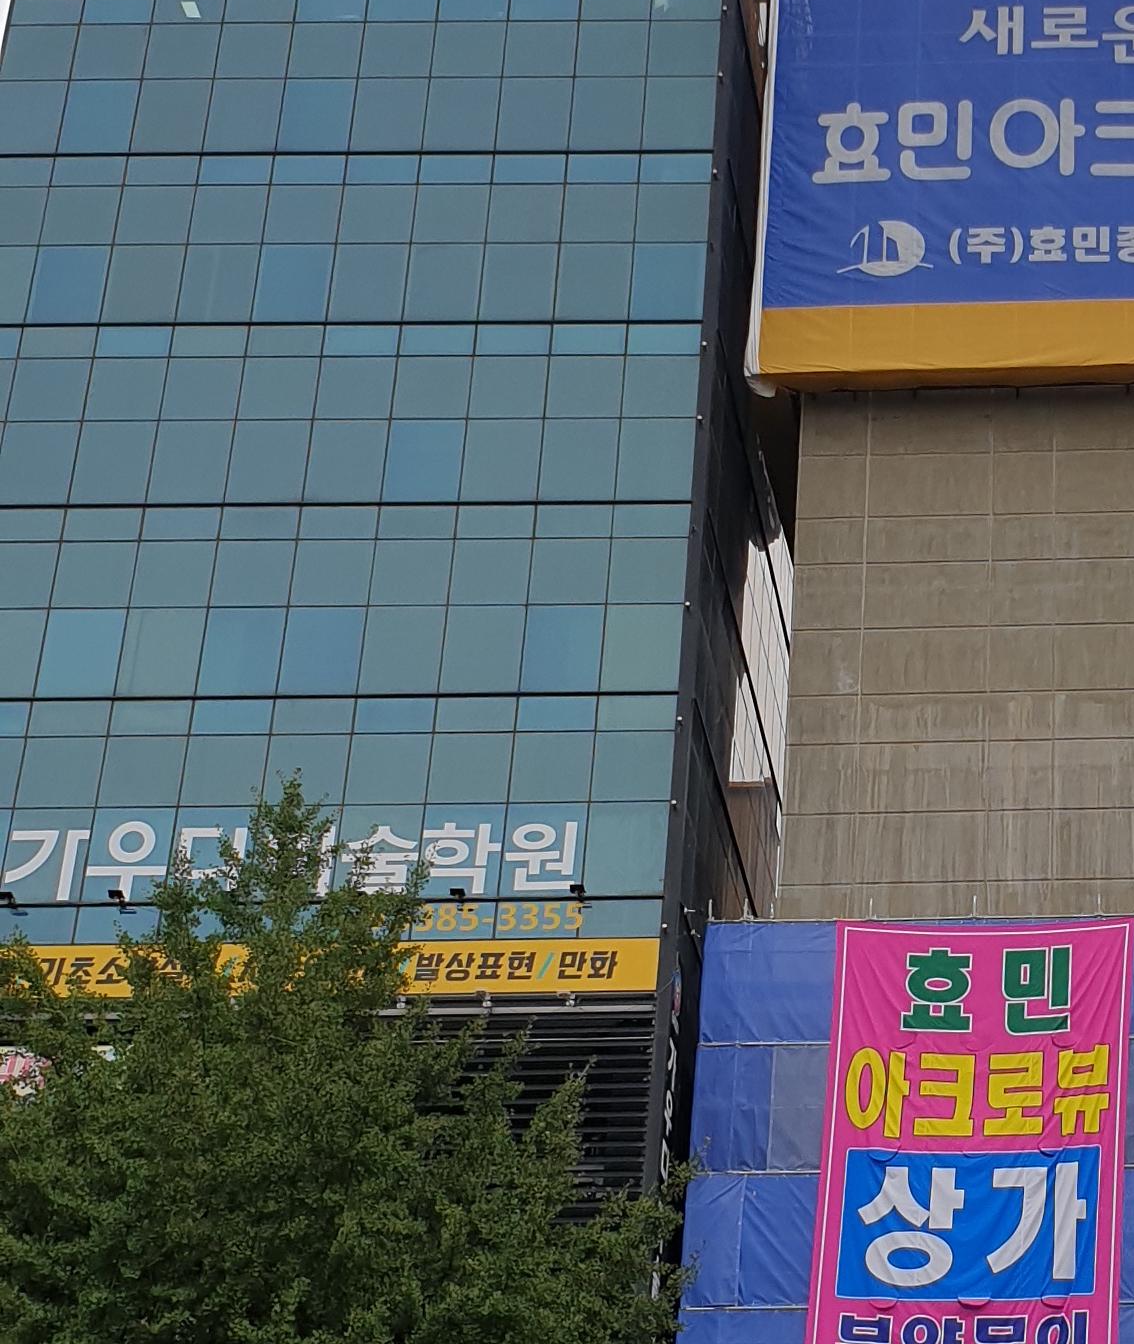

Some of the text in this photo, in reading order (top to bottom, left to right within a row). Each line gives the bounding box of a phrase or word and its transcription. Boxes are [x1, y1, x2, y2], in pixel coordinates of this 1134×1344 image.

[4, 820, 579, 901] 가우디술학원
[404, 902, 584, 933] 385-3355
[557, 950, 619, 981] 만화
[900, 944, 1073, 1036] 효민
[844, 1042, 1112, 1139] 아크로뷰
[857, 1161, 1087, 1288] 상가
